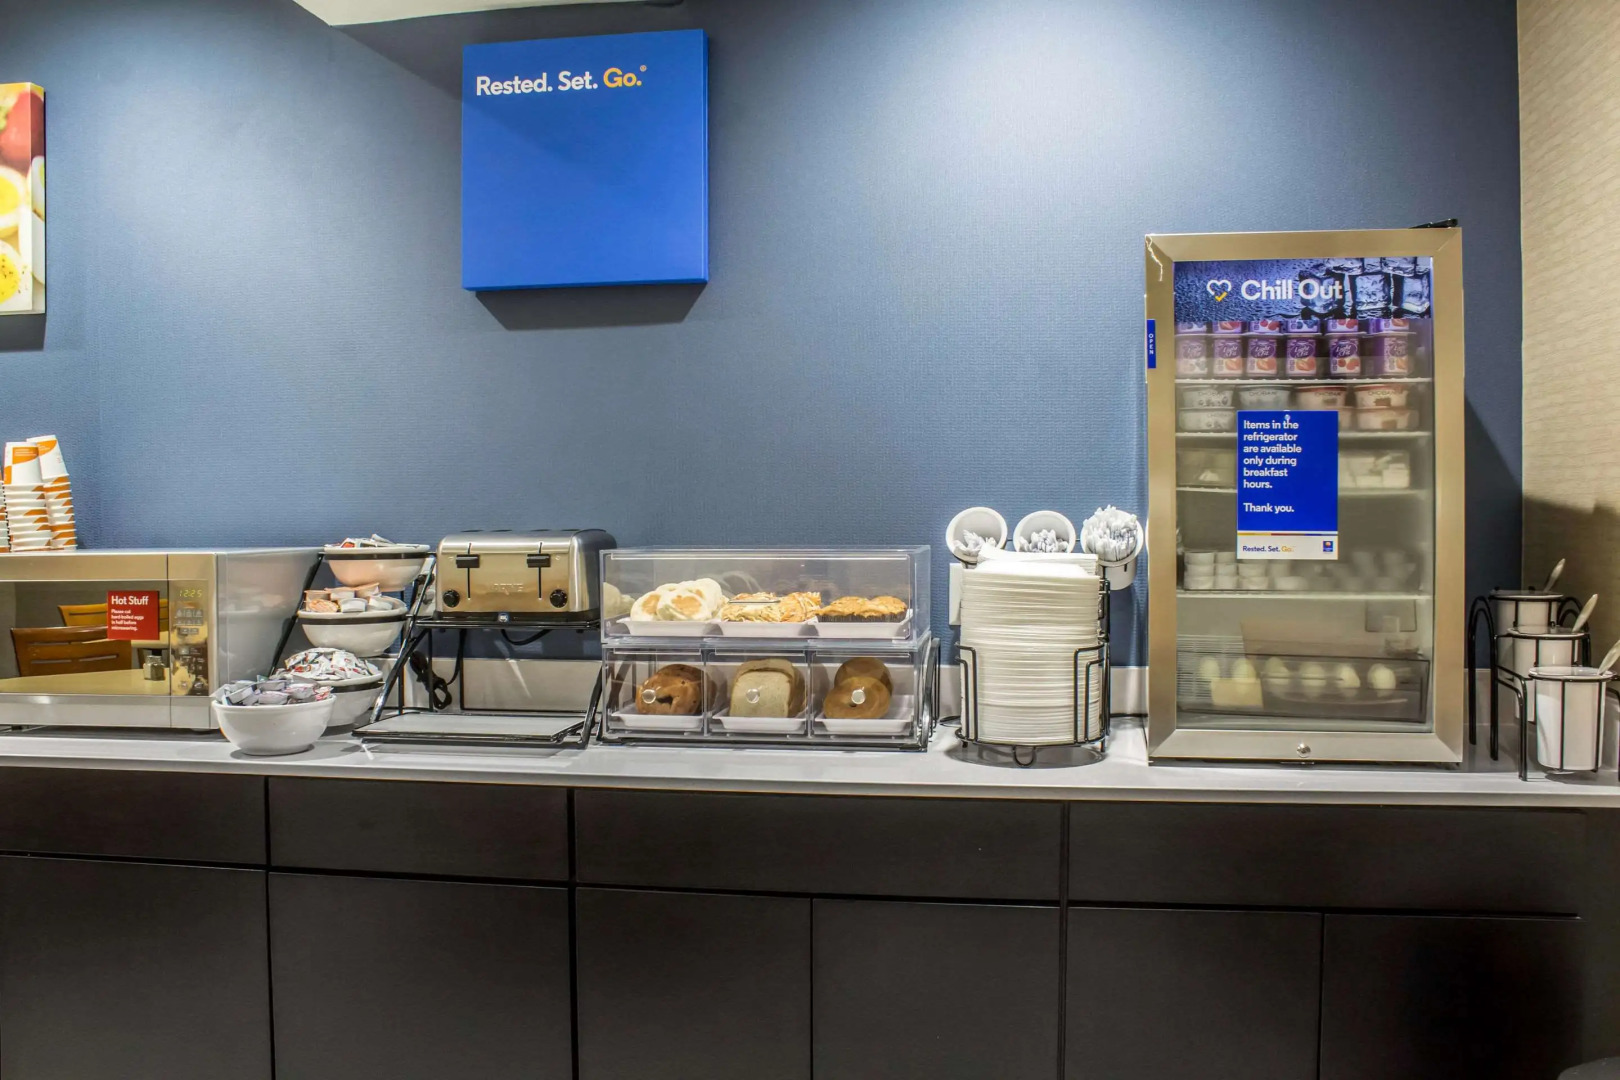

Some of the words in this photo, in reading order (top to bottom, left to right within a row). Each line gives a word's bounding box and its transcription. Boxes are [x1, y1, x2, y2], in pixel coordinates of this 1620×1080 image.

[476, 72, 553, 96] Rested.
[558, 70, 598, 91] Set.
[1241, 280, 1292, 300] Chill
[1298, 280, 1343, 300] Out
[1244, 420, 1270, 429] Items
[1272, 420, 1281, 429] in
[1283, 420, 1299, 429] the
[1243, 432, 1298, 442] refrigerator
[1260, 444, 1302, 453] available
[1243, 456, 1264, 466] only
[1265, 456, 1297, 466] during
[1243, 467, 1288, 477] breakfast
[1243, 479, 1273, 488] hours.
[1243, 502, 1273, 512] Thank
[1274, 504, 1295, 514] you.
[180, 589, 202, 598] 12:25
[112, 596, 127, 604] Hot
[128, 596, 149, 605] Stuff
